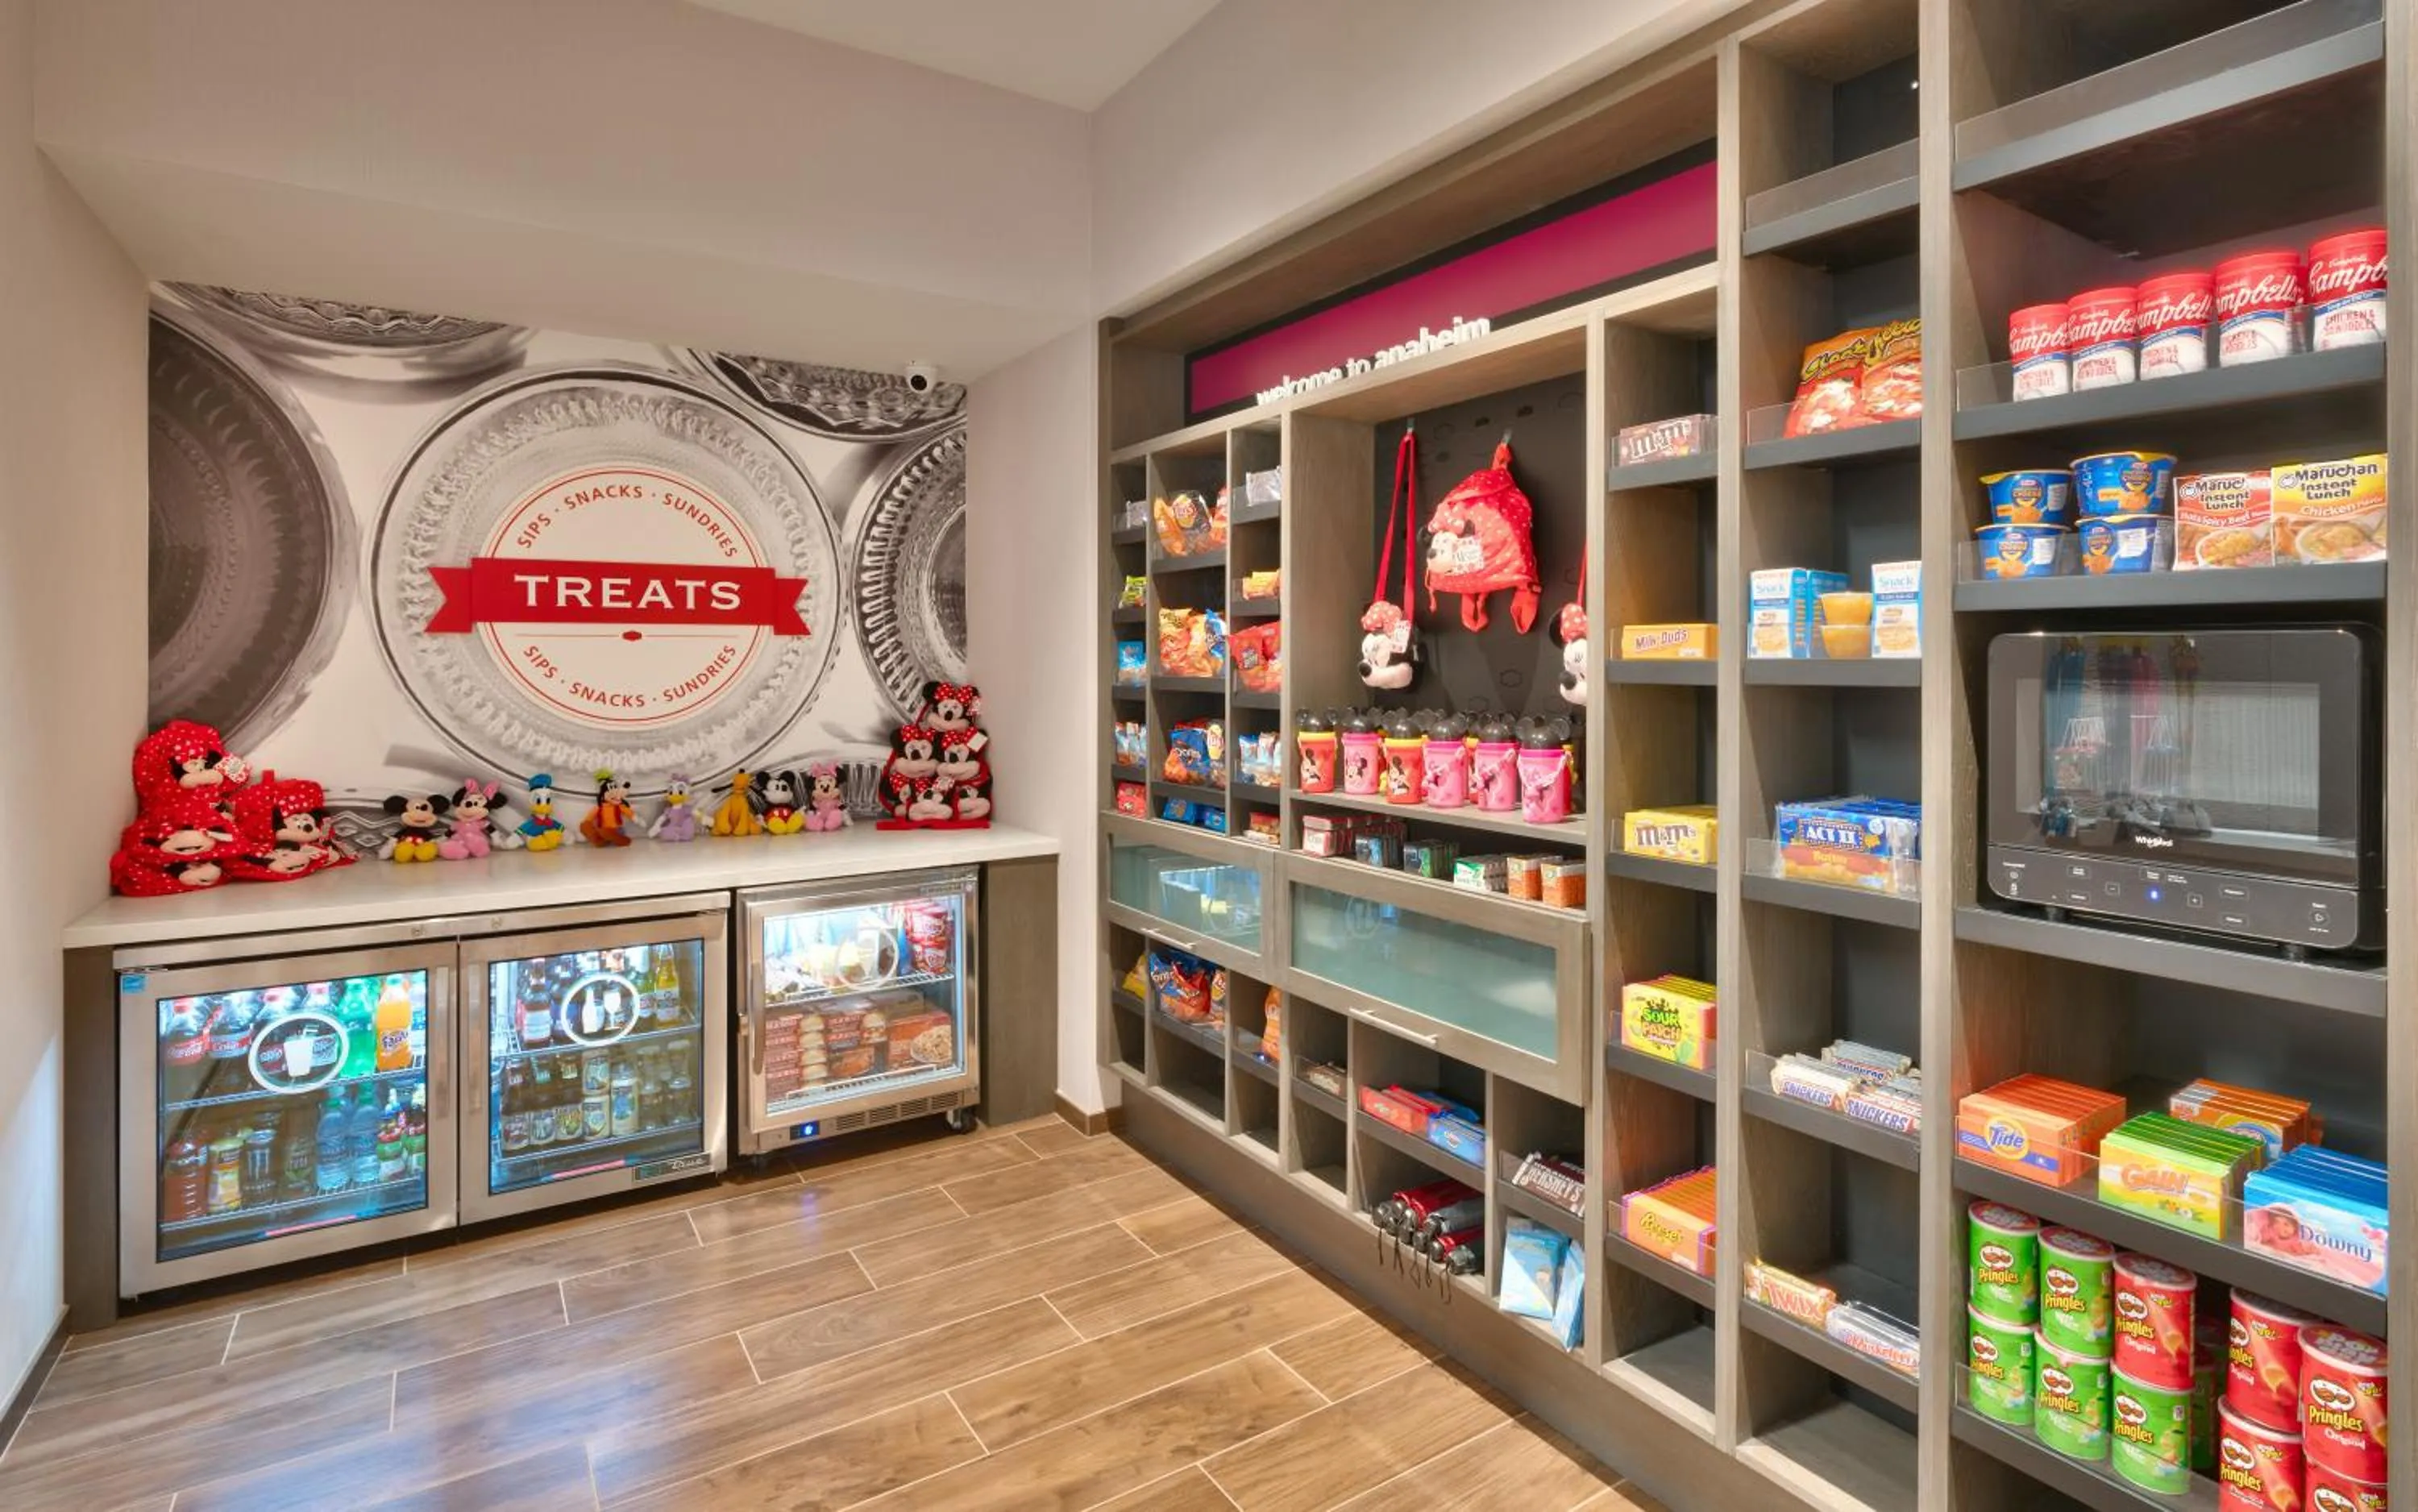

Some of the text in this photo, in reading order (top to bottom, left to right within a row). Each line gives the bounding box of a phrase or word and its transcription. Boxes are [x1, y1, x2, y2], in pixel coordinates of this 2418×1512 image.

[1257, 317, 1490, 405] welcome to anaheim
[2295, 463, 2378, 482] Maruchan
[2196, 477, 2246, 492] Maruc
[2301, 479, 2357, 492] Instant
[2307, 488, 2351, 501] Lunch
[2200, 490, 2250, 503] Instant
[2206, 500, 2245, 510] Lunch
[517, 484, 738, 559] SIPS SNACKS SUNDRIES
[2301, 505, 2355, 517] Chicken
[513, 574, 742, 611] TREATS
[523, 644, 737, 708] SIPS SNACKS SUNDRIES
[1805, 825, 1836, 841] ACT
[1643, 1007, 1681, 1027] SOUR
[1642, 1022, 1682, 1041] PATCH
[1783, 1081, 1833, 1107] SNICKERS
[1847, 1099, 1909, 1130] SNICKERS
[1988, 1123, 2025, 1149] Tide
[2299, 1224, 2373, 1263] Downy
[1979, 1268, 2019, 1285] Pringles
[2044, 1292, 2086, 1313] Pringles
[2115, 1315, 2154, 1340] Pringles
[2038, 1393, 2081, 1414] Pringles
[2308, 1405, 2364, 1433] Pringles
[2113, 1418, 2154, 1445] Pringles
[2220, 1462, 2263, 1493] Pringles
